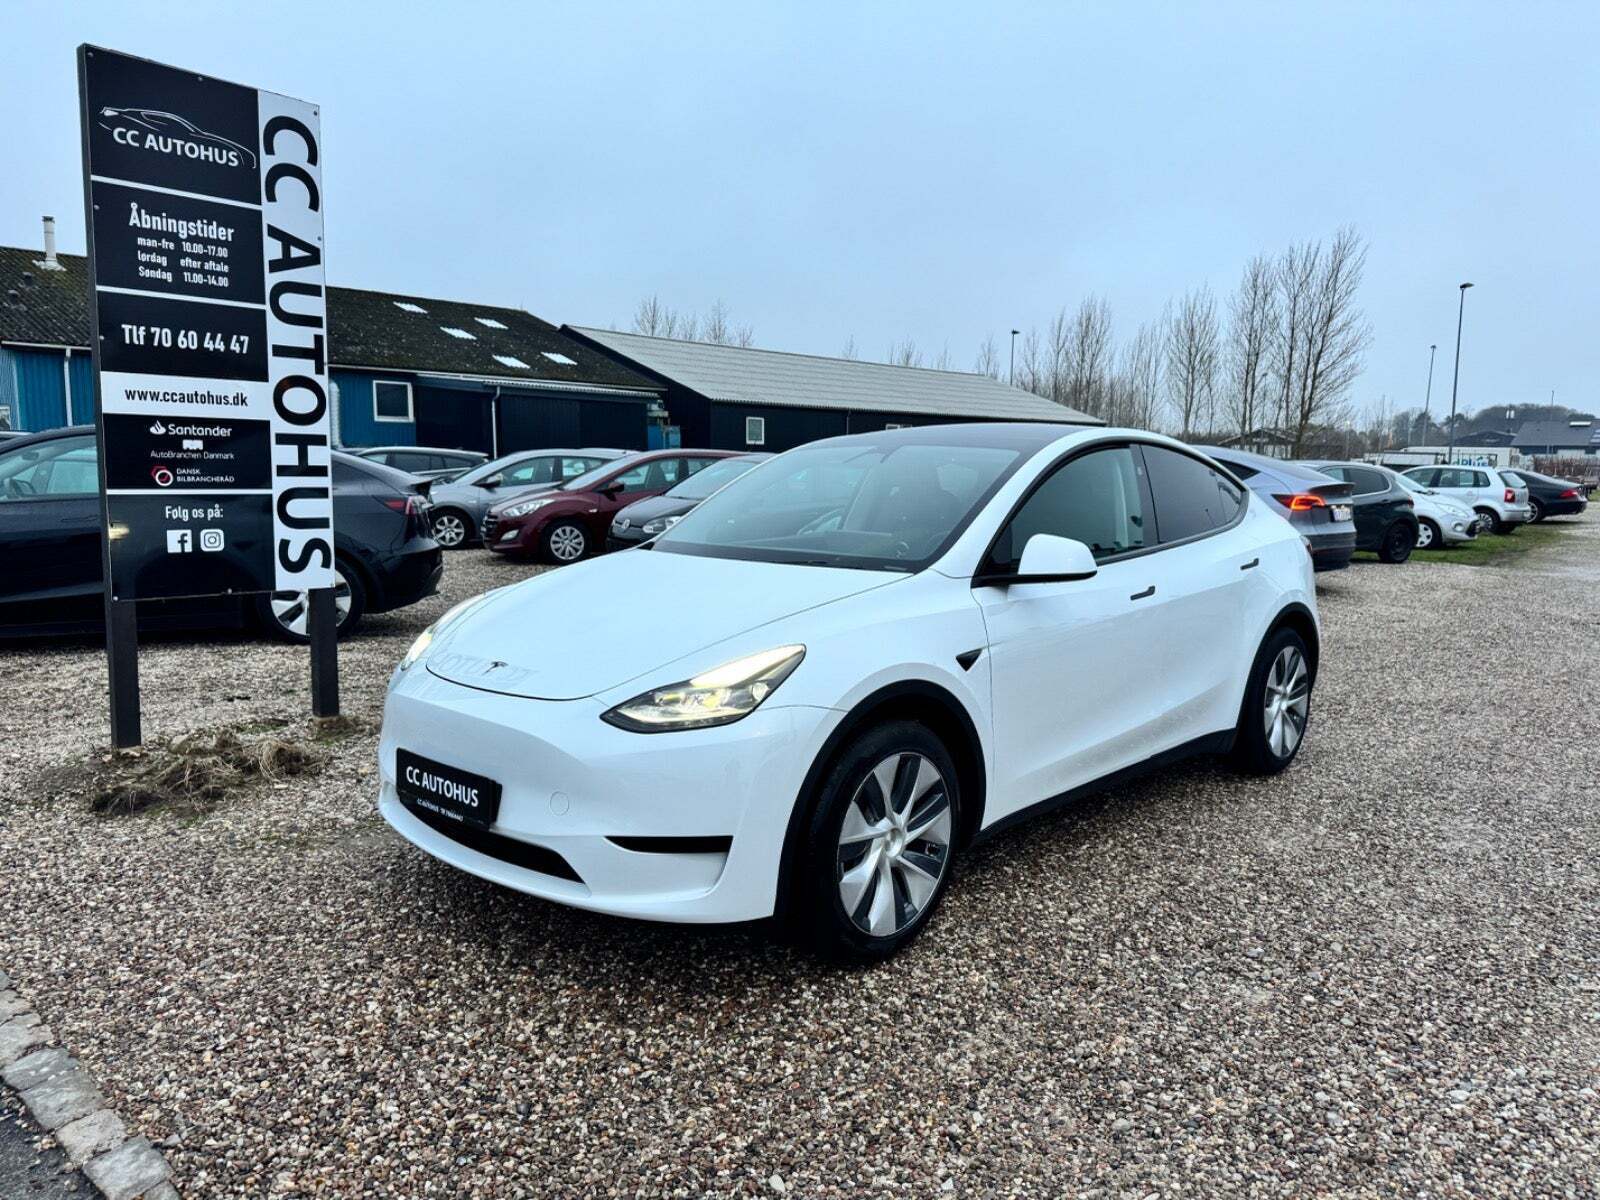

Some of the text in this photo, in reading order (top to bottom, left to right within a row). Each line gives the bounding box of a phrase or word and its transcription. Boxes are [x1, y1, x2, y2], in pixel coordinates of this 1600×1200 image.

[113, 127, 239, 167] CC AUTOHUS
[129, 202, 235, 242] Åbningstider
[137, 237, 229, 258] man-fre 10.00-17.00
[180, 257, 202, 269] efter
[204, 260, 229, 273] aftale
[183, 271, 229, 287] 11.00-14.00
[121, 324, 249, 354] Tlf 70 60 44 47
[263, 115, 332, 574] CC AUTOHUS
[125, 388, 249, 407] www.ccautohus.dk
[168, 423, 233, 437] Santander
[150, 450, 235, 460] AutoBranchen Danmark
[165, 503, 224, 522] Følg os på:
[406, 766, 479, 807] CC AUTOHUS
